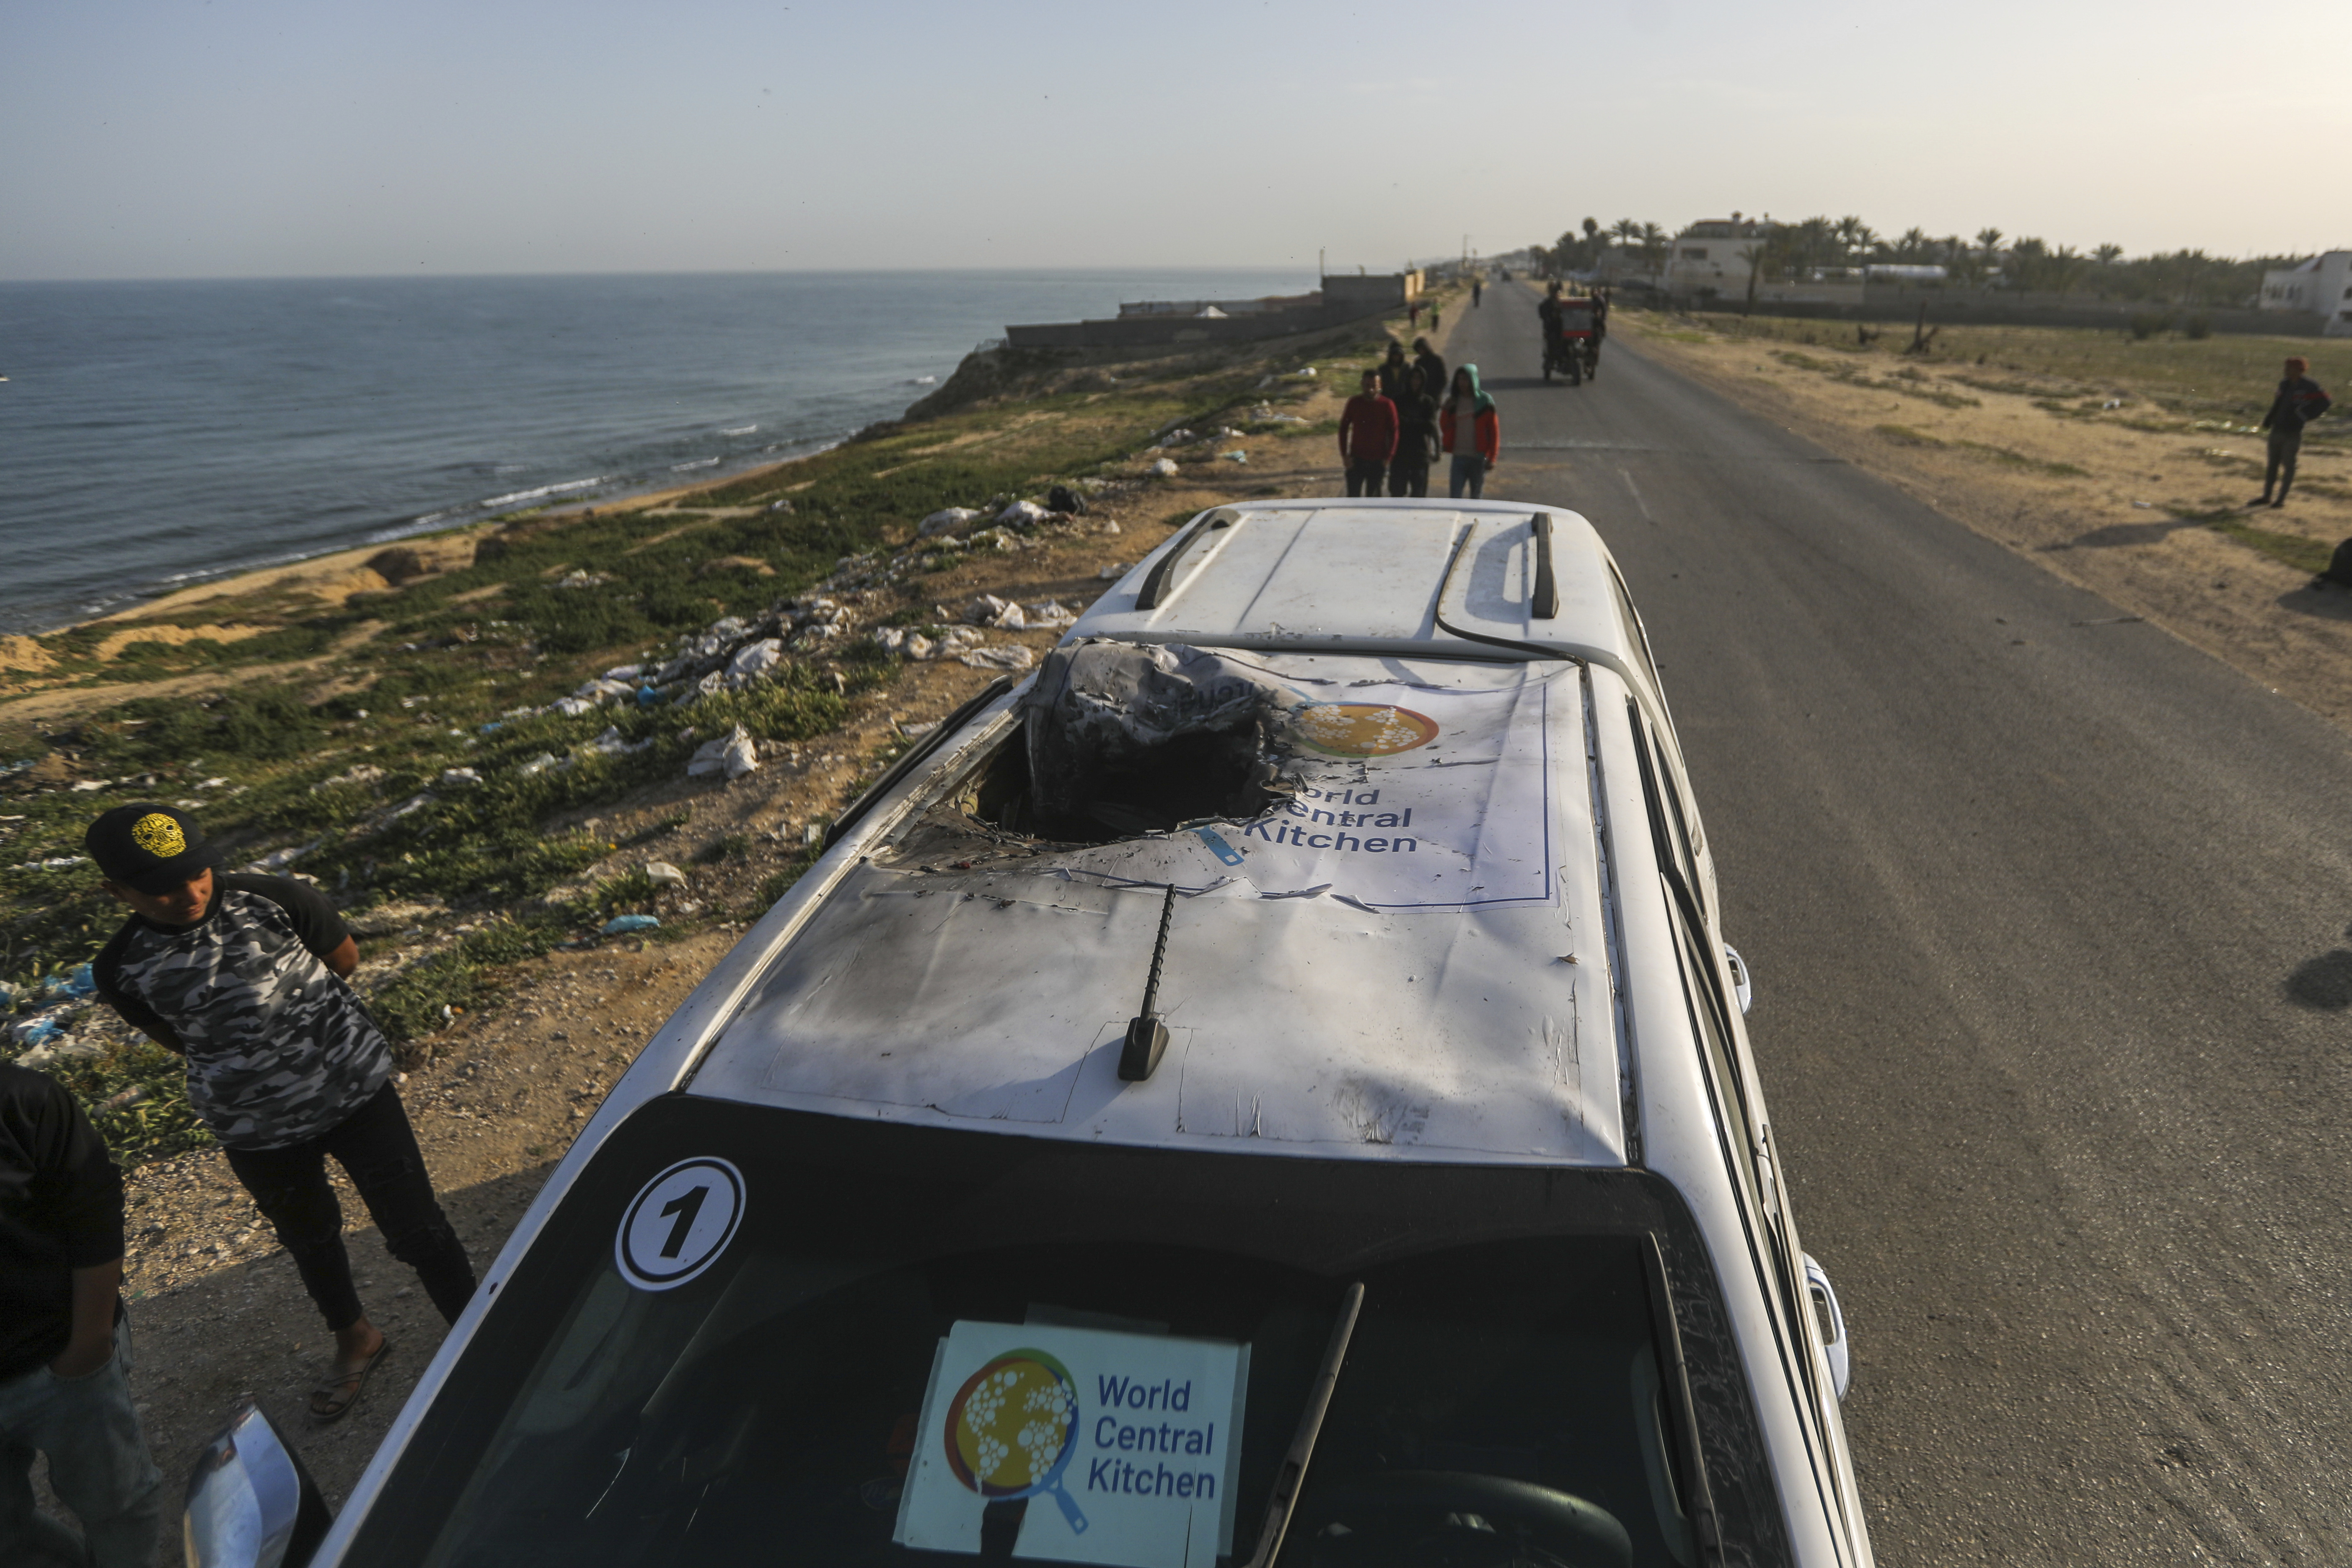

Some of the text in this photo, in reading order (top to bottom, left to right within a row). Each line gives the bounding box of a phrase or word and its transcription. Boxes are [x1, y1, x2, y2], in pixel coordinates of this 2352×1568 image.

[1278, 800, 1412, 828] entral
[1304, 787, 1381, 806] orld
[1243, 817, 1417, 853] Kitchen
[659, 1185, 710, 1259] 1
[1098, 1374, 1191, 1413] World
[1094, 1415, 1214, 1456] Central
[1088, 1457, 1216, 1499] Kitchen
